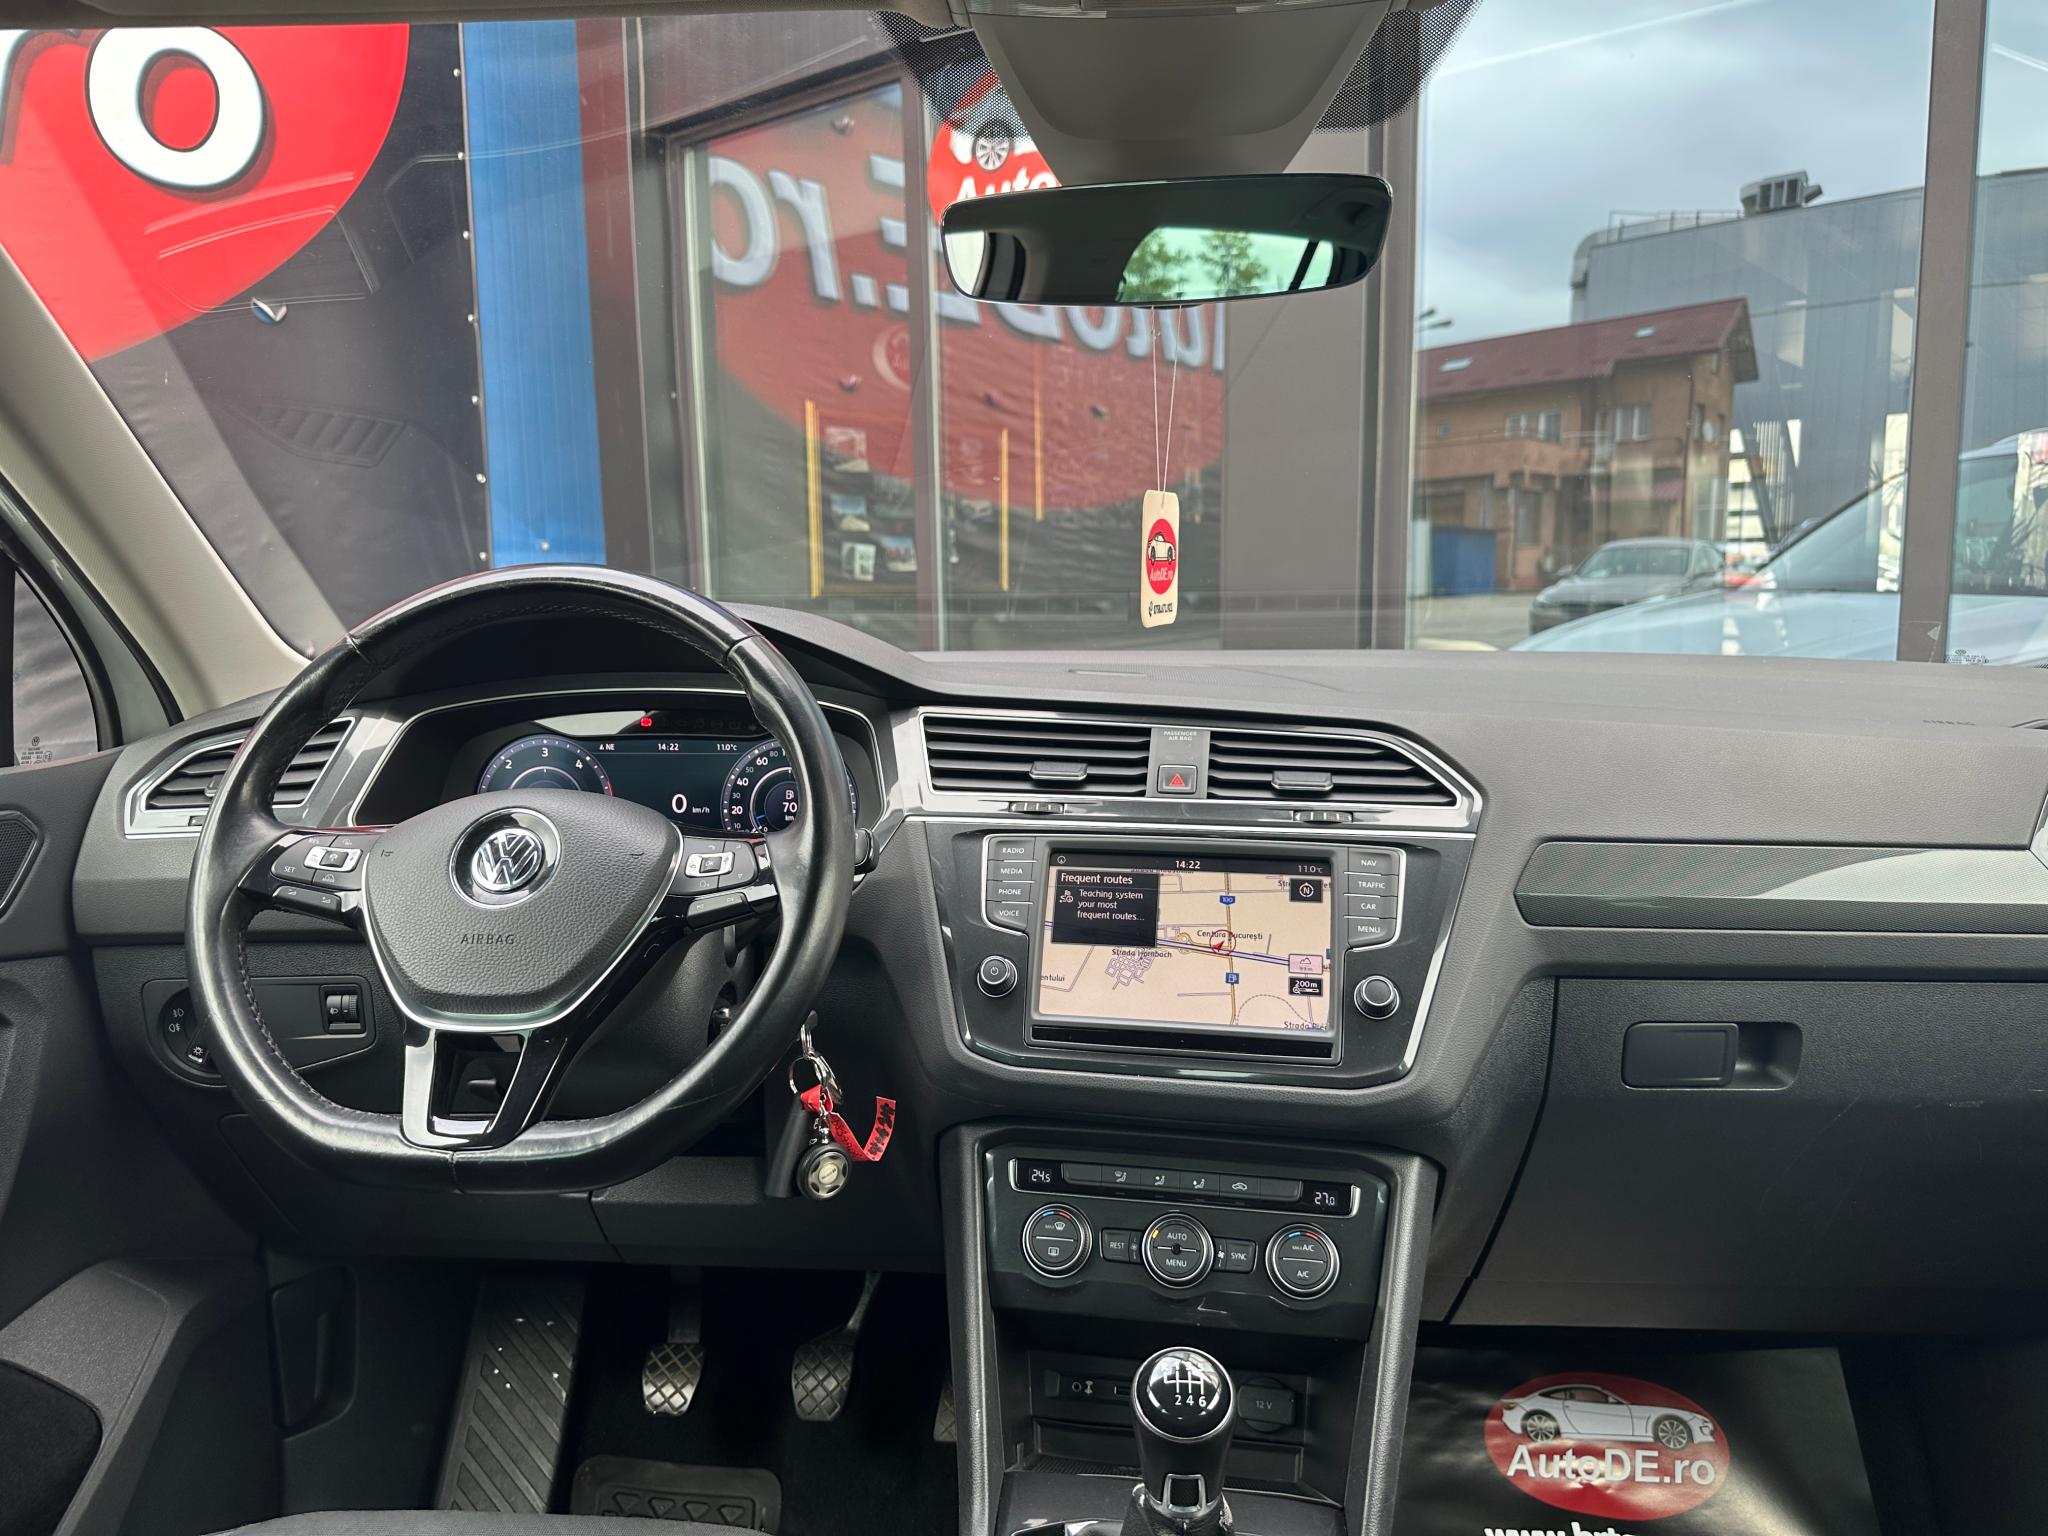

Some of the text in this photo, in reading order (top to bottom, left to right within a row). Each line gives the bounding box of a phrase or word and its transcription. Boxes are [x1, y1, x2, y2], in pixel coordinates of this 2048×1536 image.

[605, 743, 615, 751] NE
[657, 743, 679, 751] 14:22
[541, 747, 549, 757] 3
[505, 760, 513, 769] 2
[575, 760, 583, 769] 4
[756, 757, 769, 766] 60
[736, 777, 749, 786] 40
[671, 793, 688, 814] 0
[782, 802, 798, 813] 70
[731, 805, 743, 815] 20
[1175, 860, 1201, 869] 14:22
[1000, 867, 1023, 875] MEDIA
[1060, 872, 1133, 885] Frequent routes
[1358, 881, 1386, 889] TRAFFIC
[1079, 889, 1144, 901] Teaching system
[1077, 901, 1117, 910] your most
[1360, 902, 1377, 910] CAR
[1077, 910, 1110, 921] frequent
[1196, 929, 1227, 938] Centura
[1357, 925, 1381, 934] MENU
[460, 934, 515, 945] AIRBAG
[1111, 948, 1136, 957] Strada
[1031, 1169, 1051, 1183] 24.5
[1314, 1191, 1336, 1207] 27.0
[1167, 1231, 1188, 1241] AUTO
[1109, 1241, 1125, 1249] REST
[1302, 1243, 1315, 1252] A/C
[1230, 1251, 1248, 1261] SYNC
[1165, 1258, 1188, 1268] MENU
[1296, 1269, 1310, 1278] A/C
[1174, 1394, 1207, 1408] 2 4 6
[1255, 1400, 1273, 1410] 12 V
[1506, 1443, 1717, 1486] AutoDE.ro
